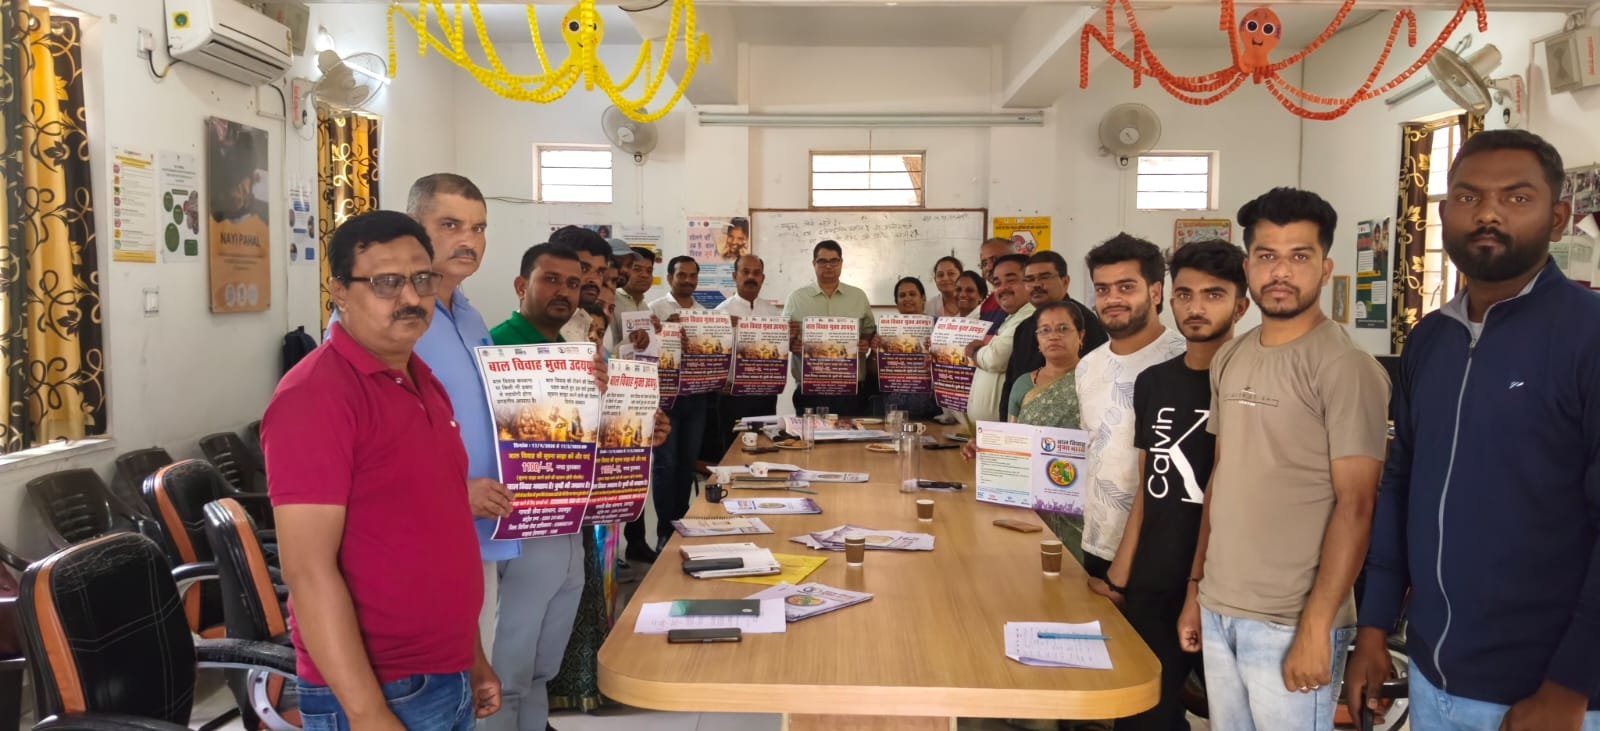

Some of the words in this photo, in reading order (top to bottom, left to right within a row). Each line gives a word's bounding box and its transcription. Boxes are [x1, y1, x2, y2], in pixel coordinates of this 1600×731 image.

[220, 232, 238, 246] NAYI
[239, 233, 261, 248] PAHAL
[488, 360, 510, 372] बाल
[512, 357, 542, 371] विवाह
[545, 359, 566, 372] मुक्त
[1148, 407, 1175, 498] Calvin
